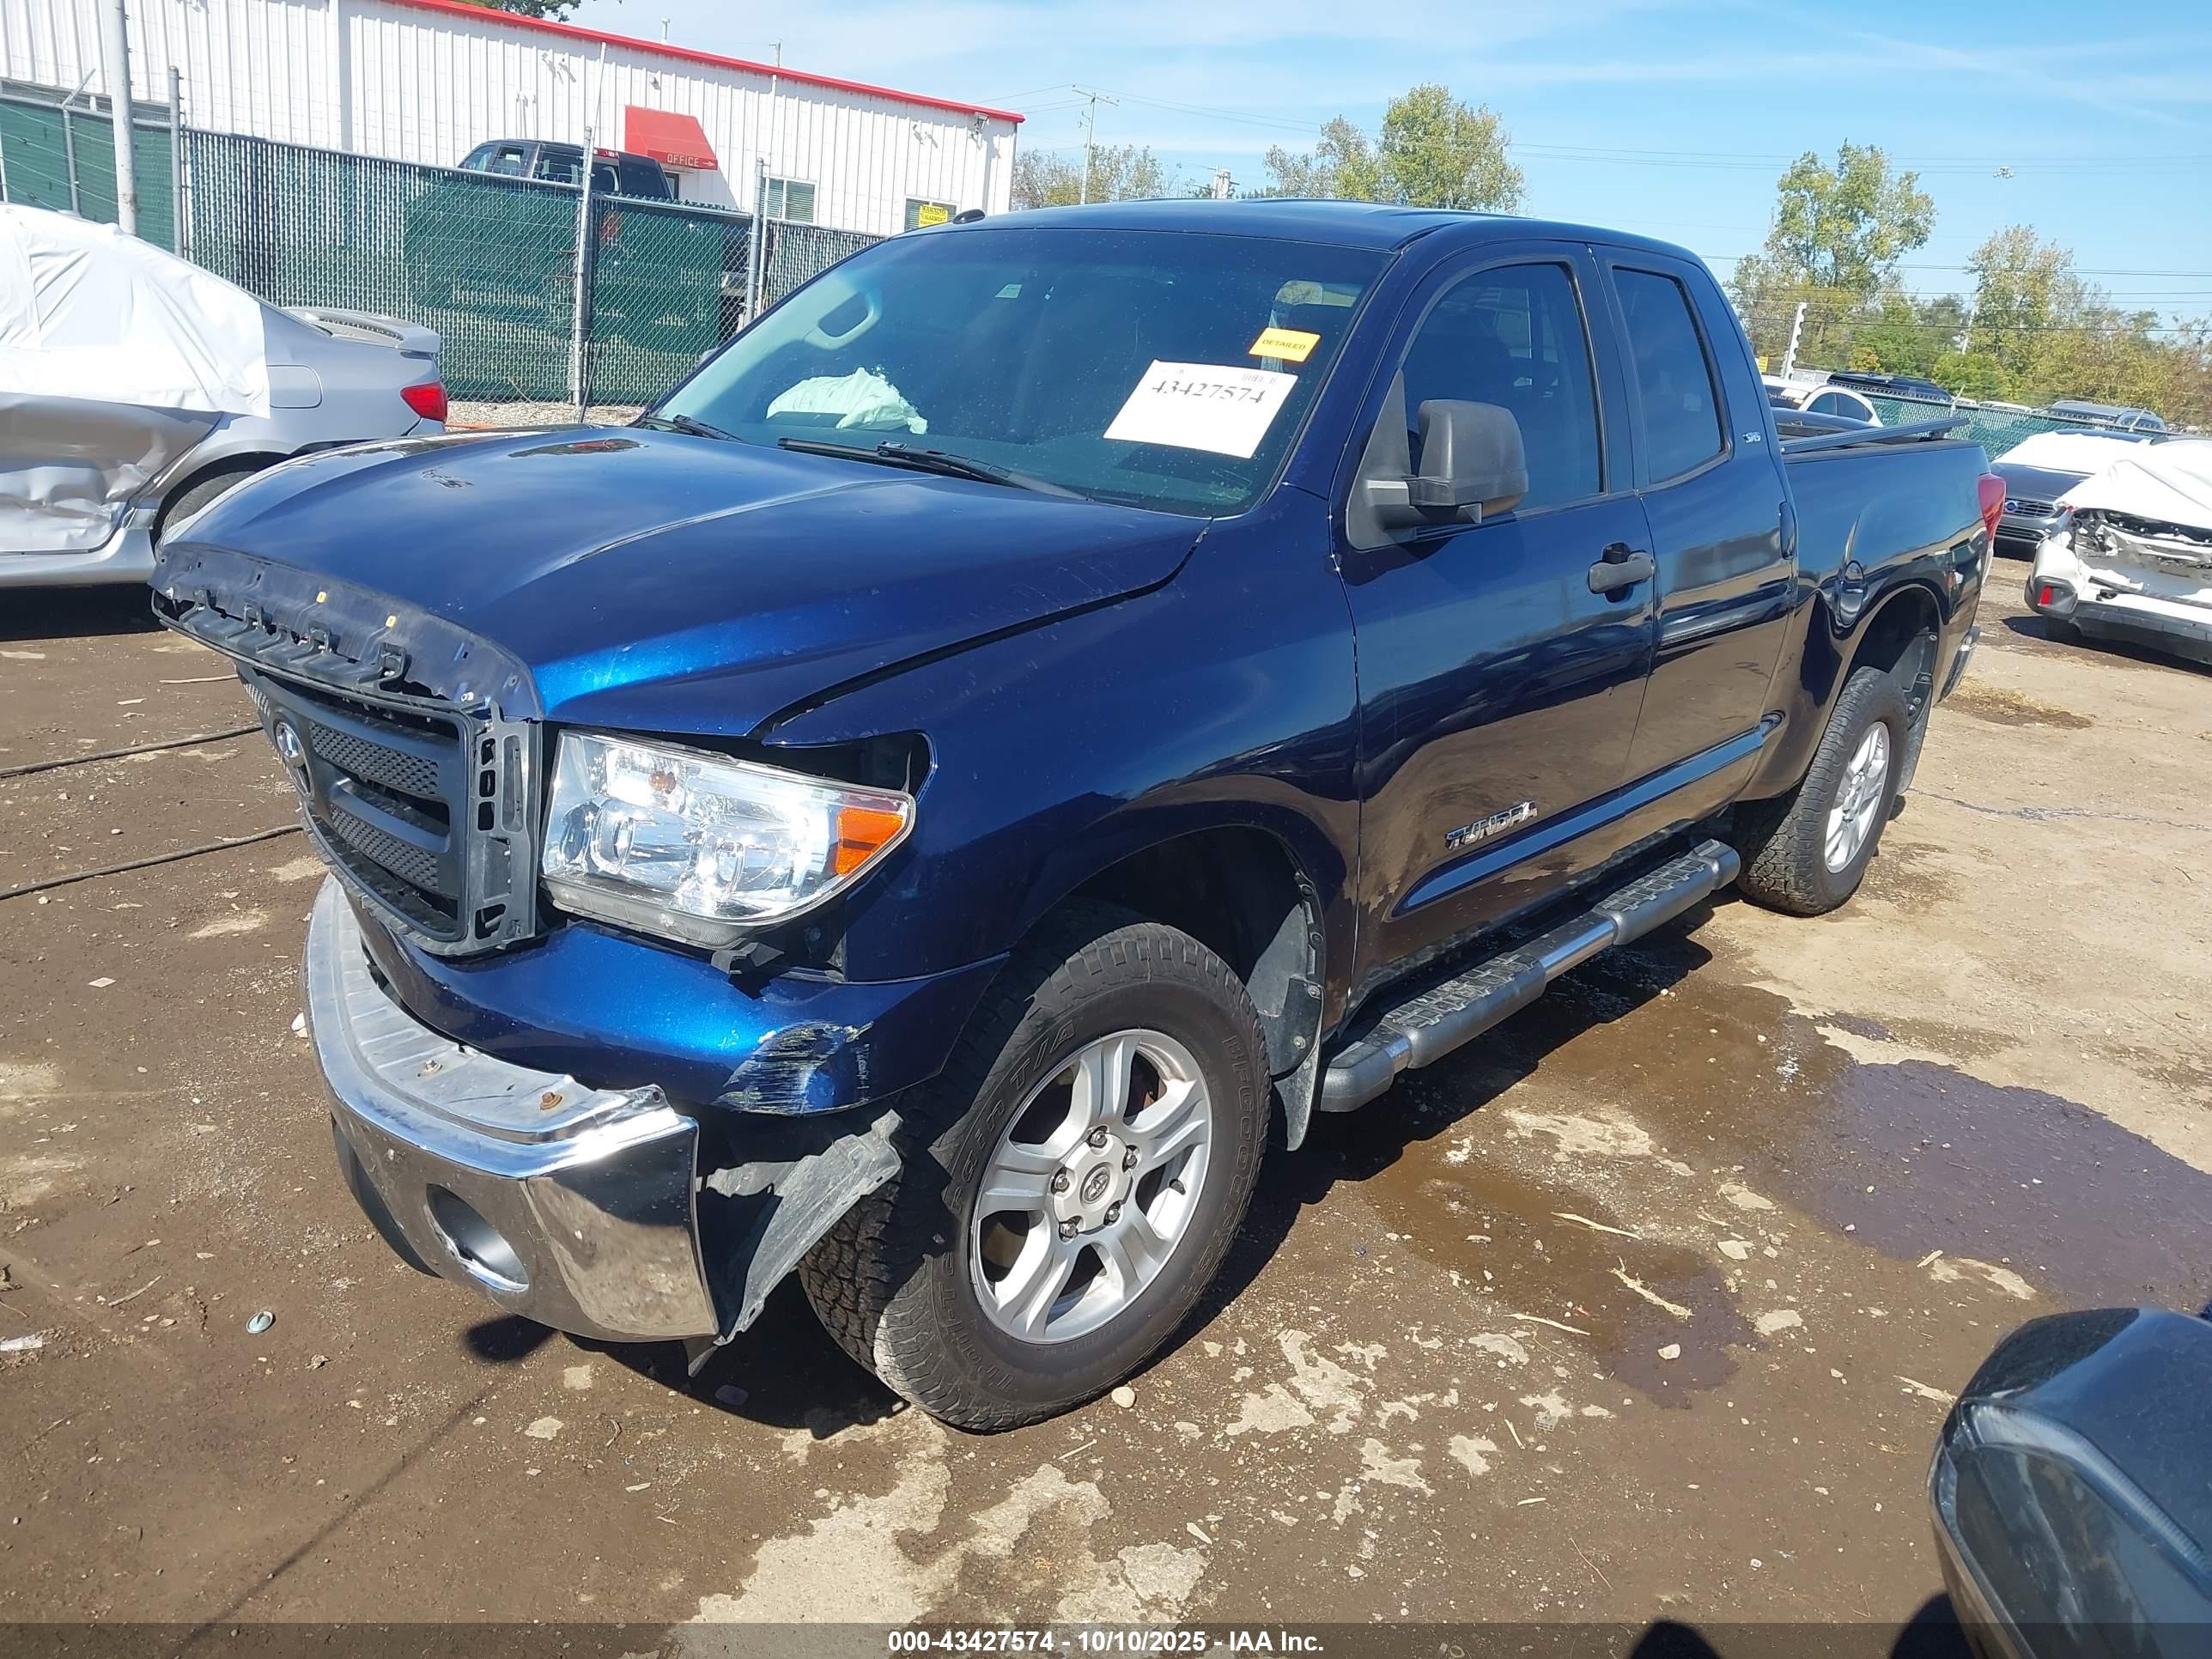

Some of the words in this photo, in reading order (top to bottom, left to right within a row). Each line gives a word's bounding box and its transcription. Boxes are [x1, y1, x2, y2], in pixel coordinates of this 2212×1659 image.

[666, 154, 700, 167] OFFICE
[1262, 339, 1306, 350] DETAILED
[1152, 380, 1266, 404] 43427574
[1446, 799, 1539, 850] TUNDRA
